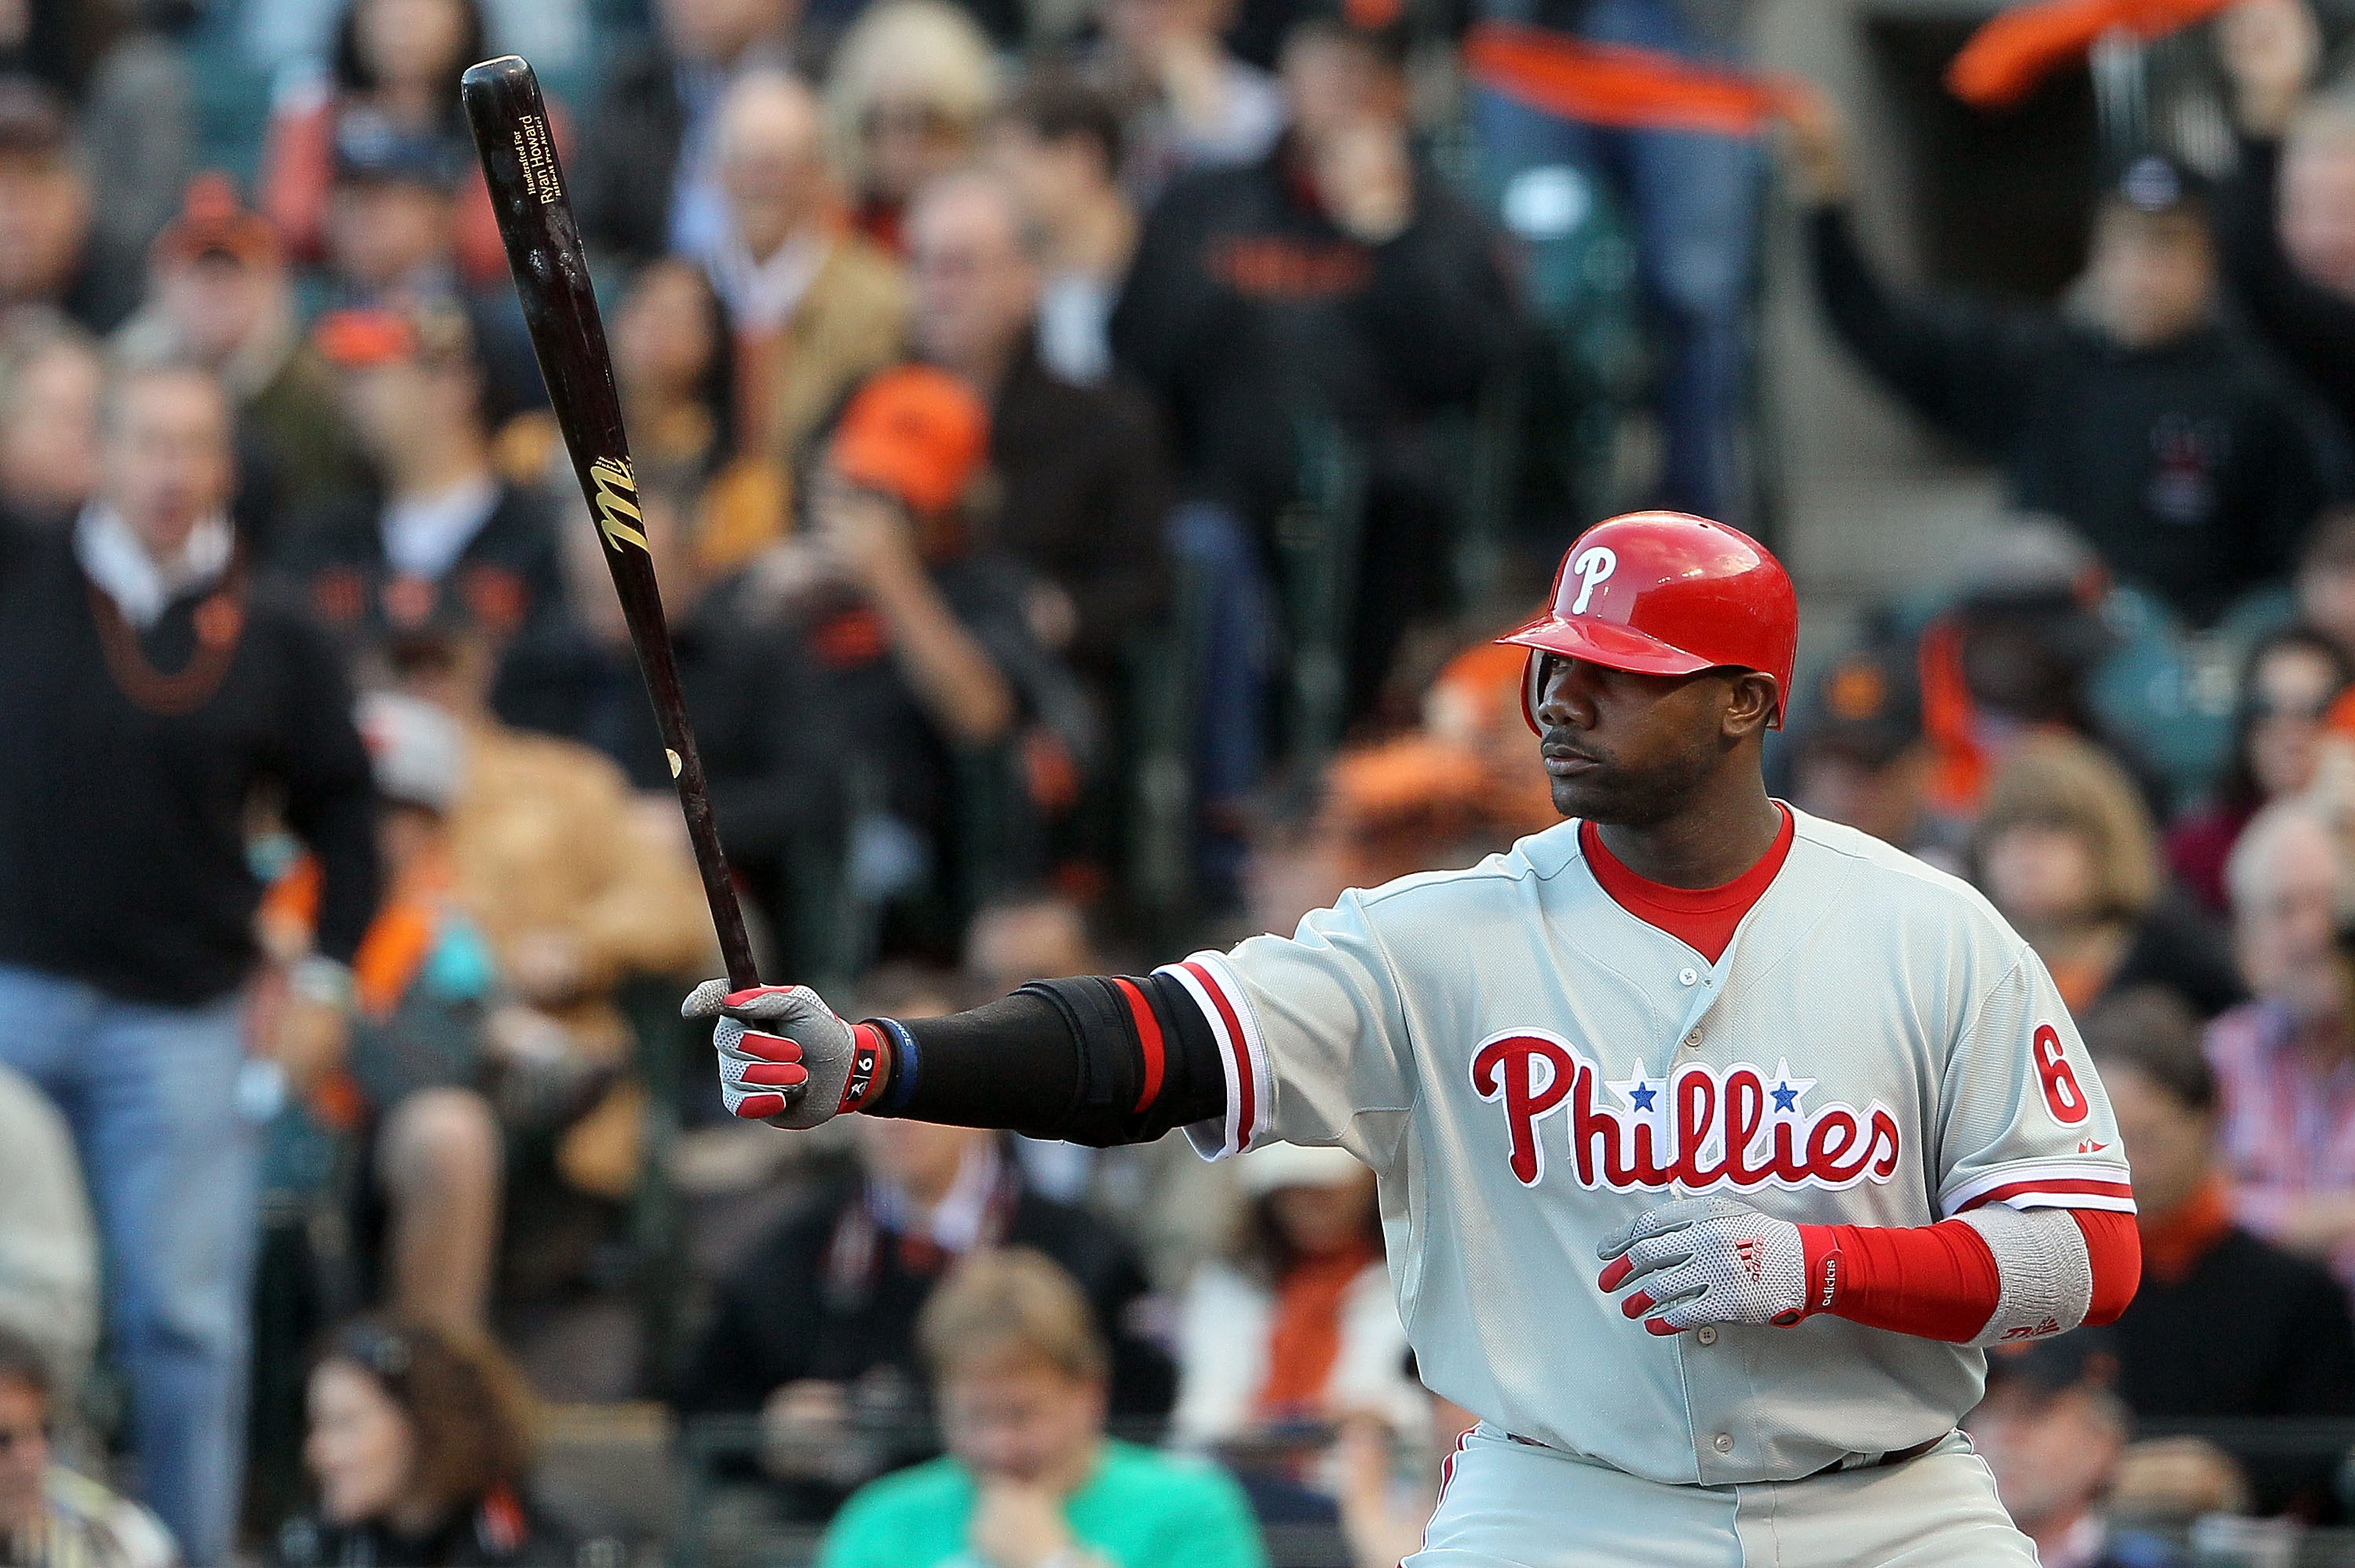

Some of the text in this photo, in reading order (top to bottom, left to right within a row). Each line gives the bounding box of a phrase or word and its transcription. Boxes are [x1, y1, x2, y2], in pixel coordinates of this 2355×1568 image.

[518, 115, 554, 205] Ryan Howard
[534, 116, 548, 144] Model
[513, 131, 537, 195] Handcrafted For
[1572, 545, 1618, 615] P
[858, 1057, 873, 1071] 6
[2032, 1023, 2090, 1124] 6
[1471, 1034, 1900, 1184] Phillies
[1751, 1233, 1766, 1282] adidas
[1821, 1259, 1836, 1307] adidas
